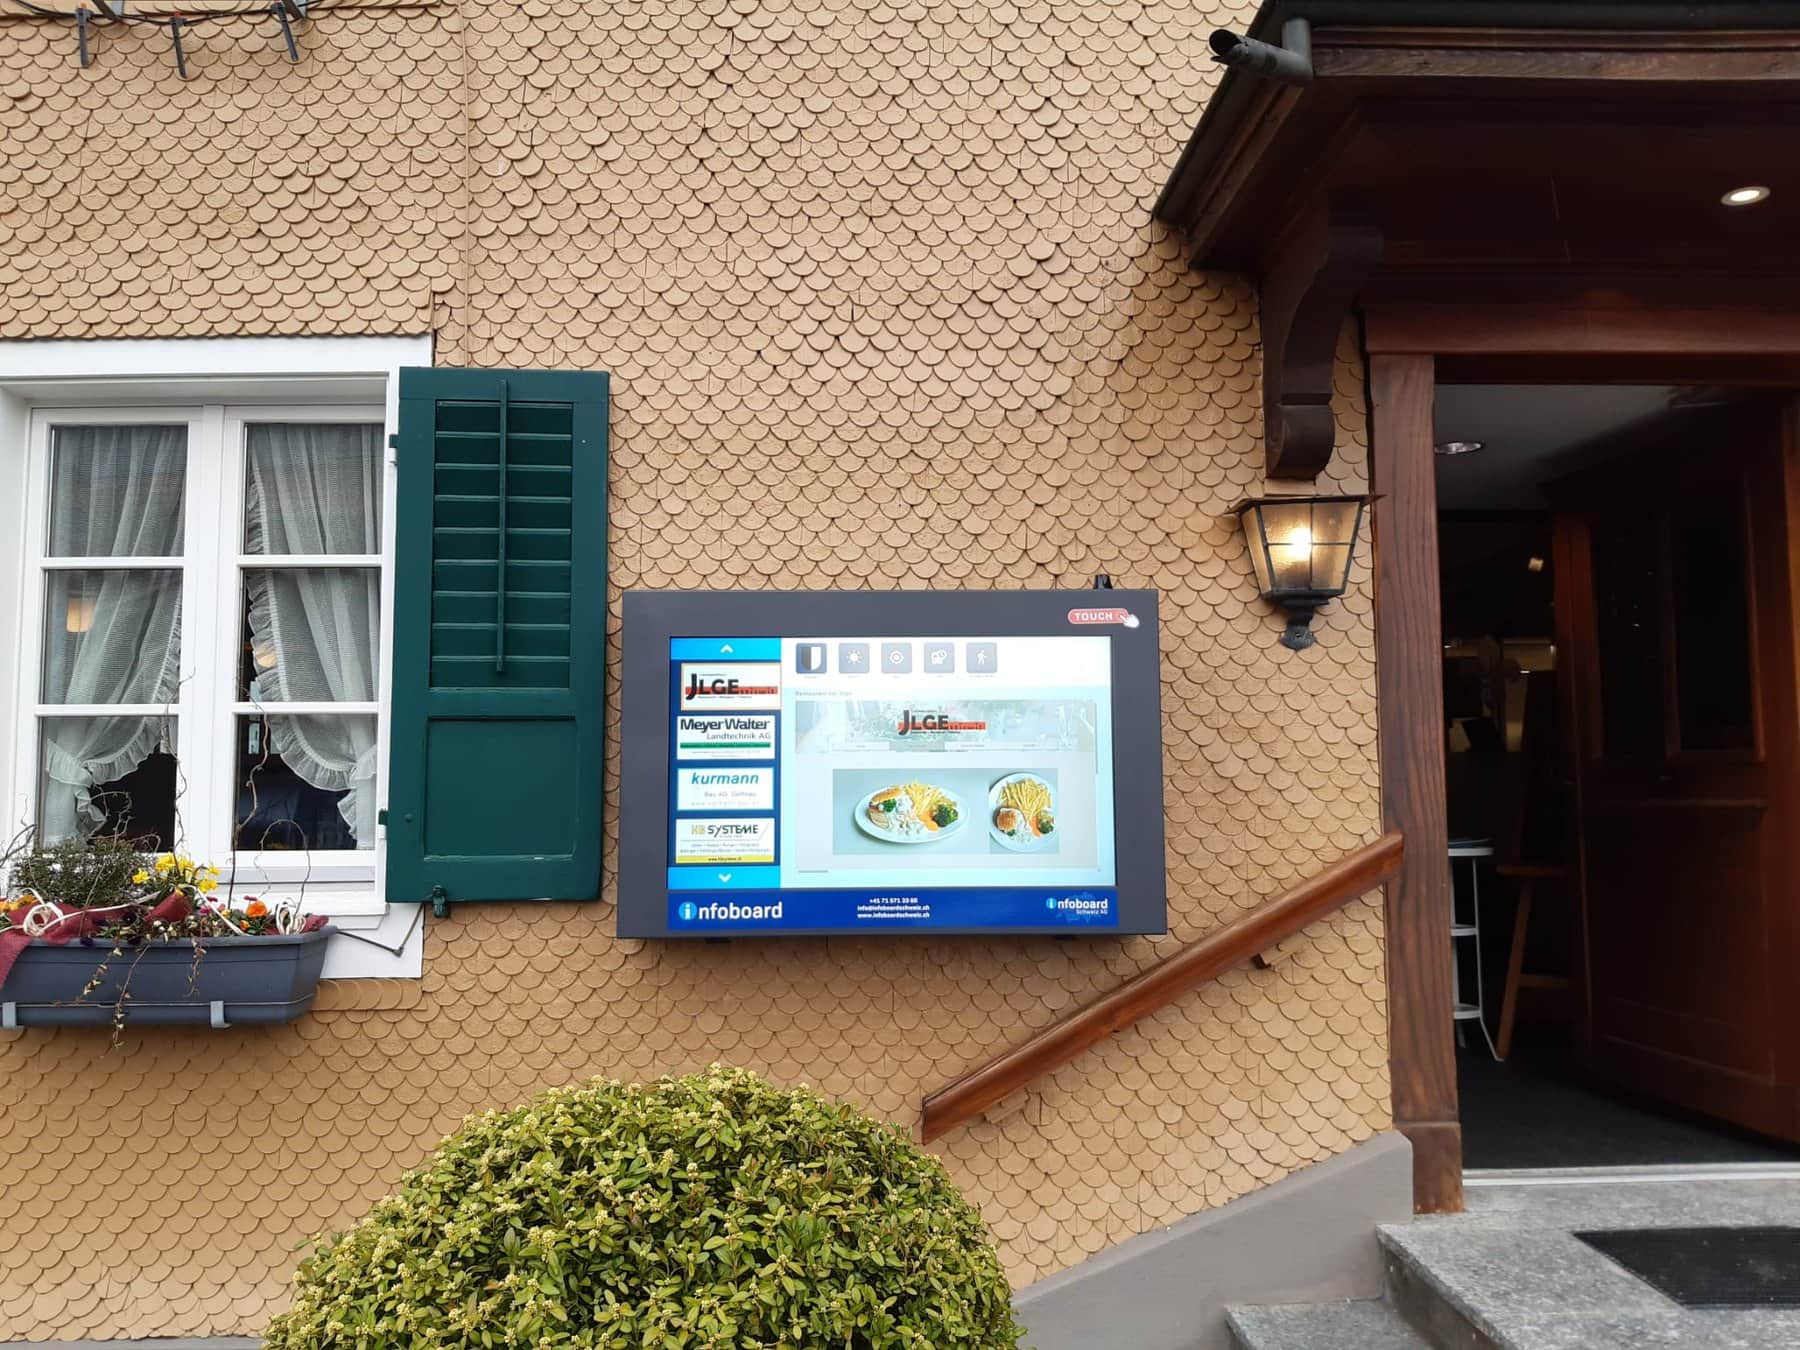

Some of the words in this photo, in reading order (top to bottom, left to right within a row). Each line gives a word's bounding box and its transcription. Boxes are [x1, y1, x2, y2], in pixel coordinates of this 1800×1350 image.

[1074, 612, 1113, 621] TOUCH
[680, 718, 723, 733] Meyer
[724, 718, 770, 730] Walter
[706, 732, 756, 740] Landtechnik
[758, 732, 771, 740] AG
[691, 772, 759, 784] kurmann
[679, 901, 783, 920] infoboard
